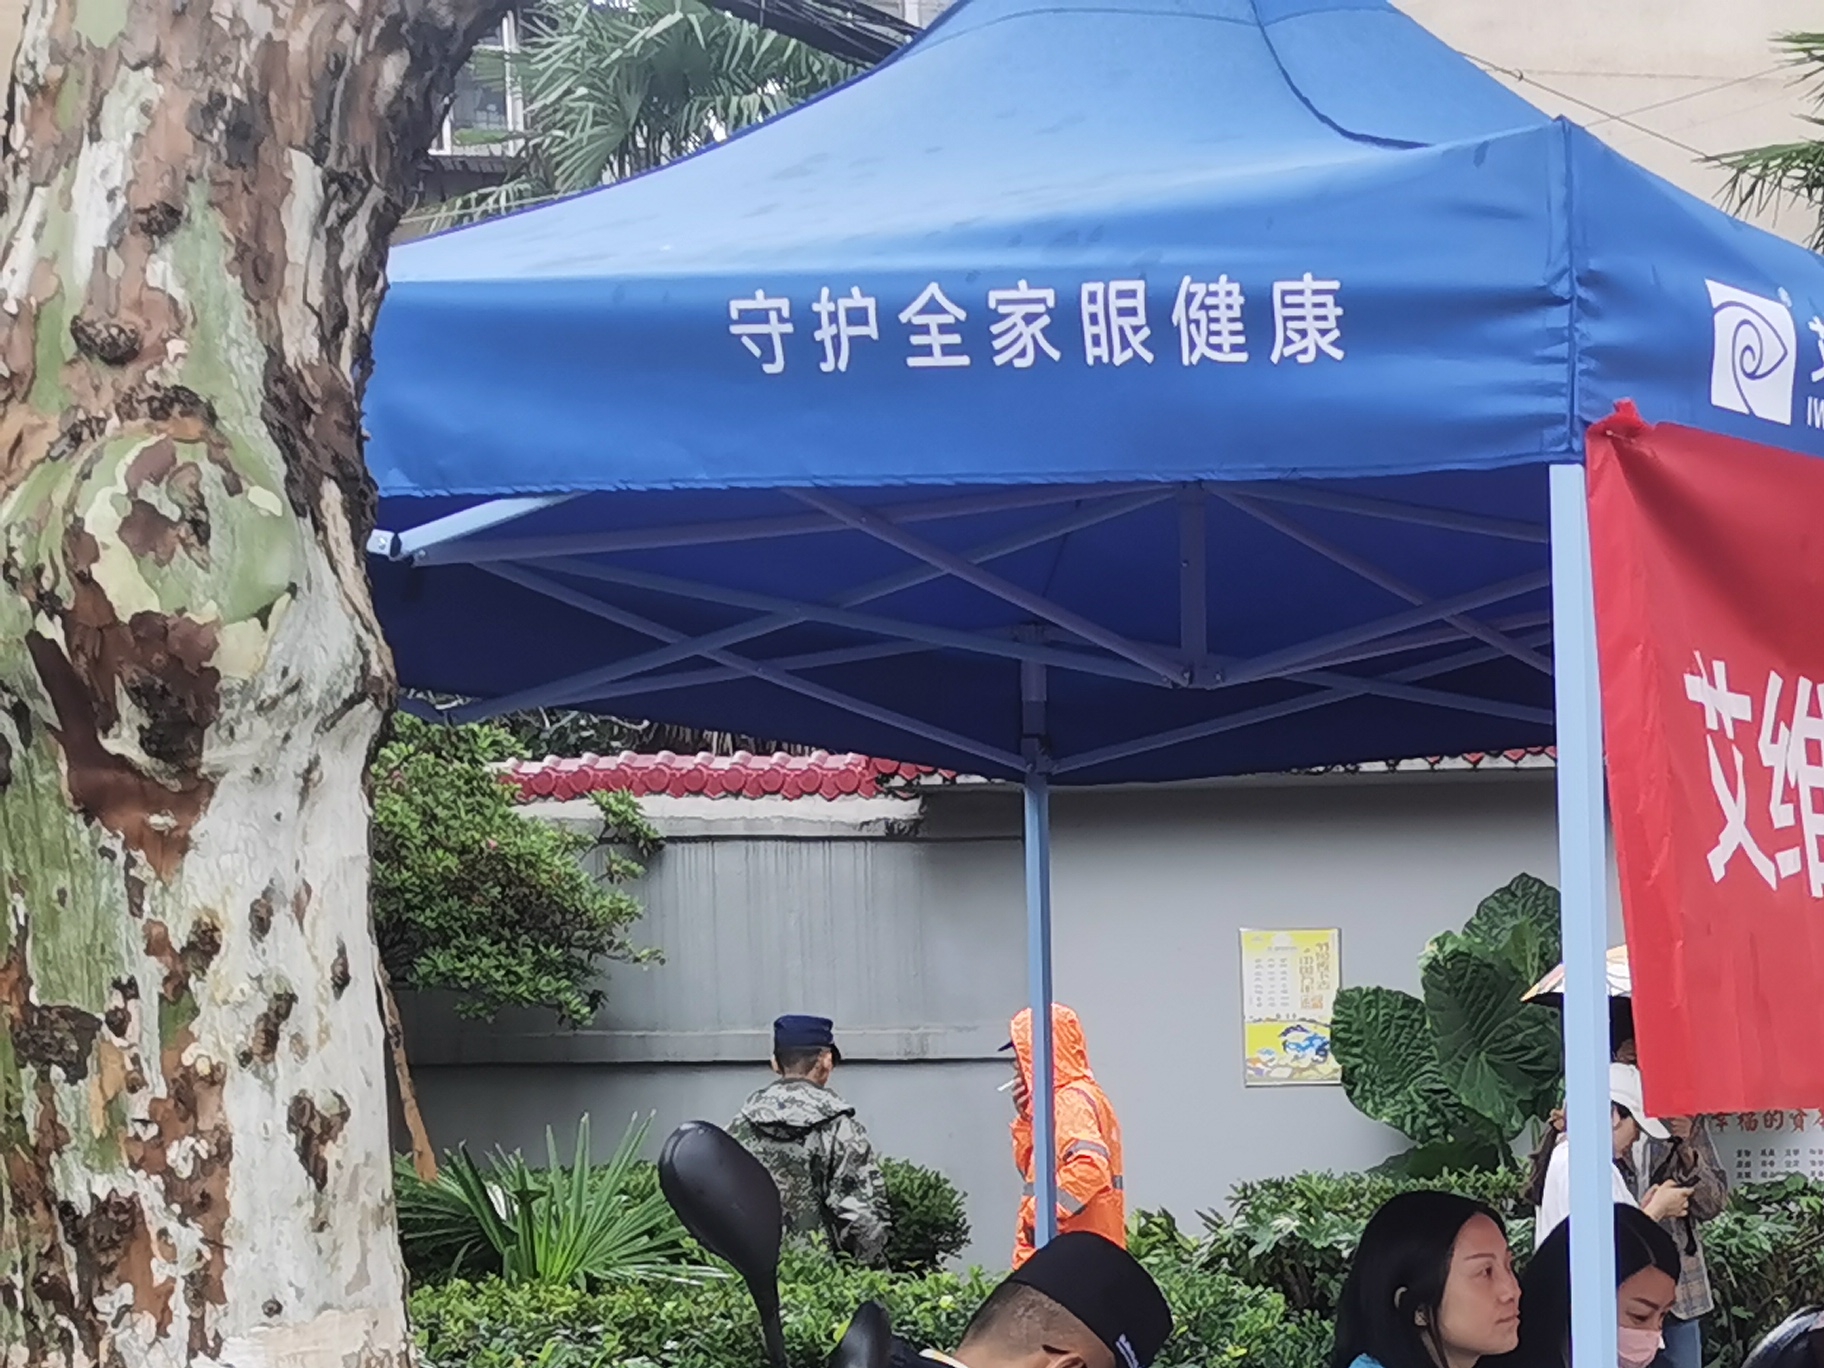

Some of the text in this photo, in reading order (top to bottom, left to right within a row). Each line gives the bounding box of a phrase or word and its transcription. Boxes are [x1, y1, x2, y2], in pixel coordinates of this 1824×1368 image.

[728, 271, 1345, 375] 守护全家眼健康
